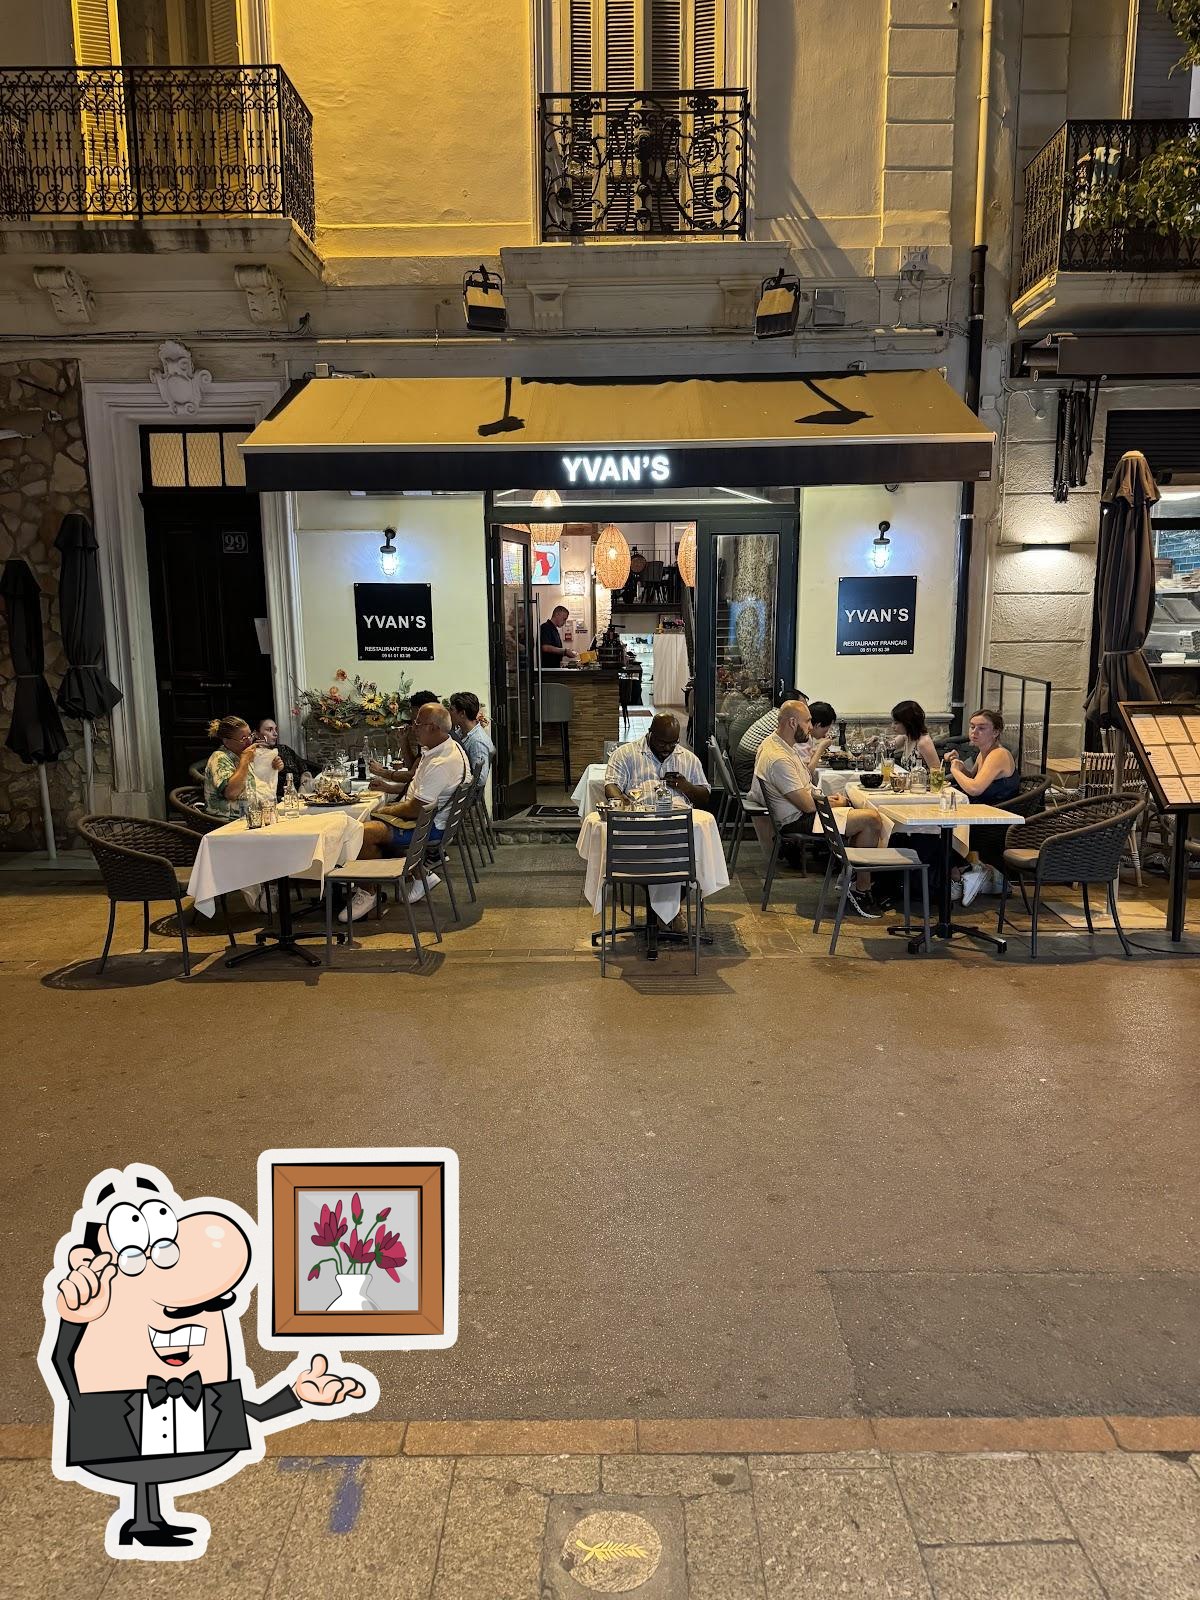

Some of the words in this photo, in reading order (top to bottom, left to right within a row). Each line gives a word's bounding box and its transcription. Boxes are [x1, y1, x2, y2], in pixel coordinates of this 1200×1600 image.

[561, 455, 670, 482] YVAN'S
[362, 615, 427, 629] YVAN'S
[844, 608, 909, 623] YVAN'S
